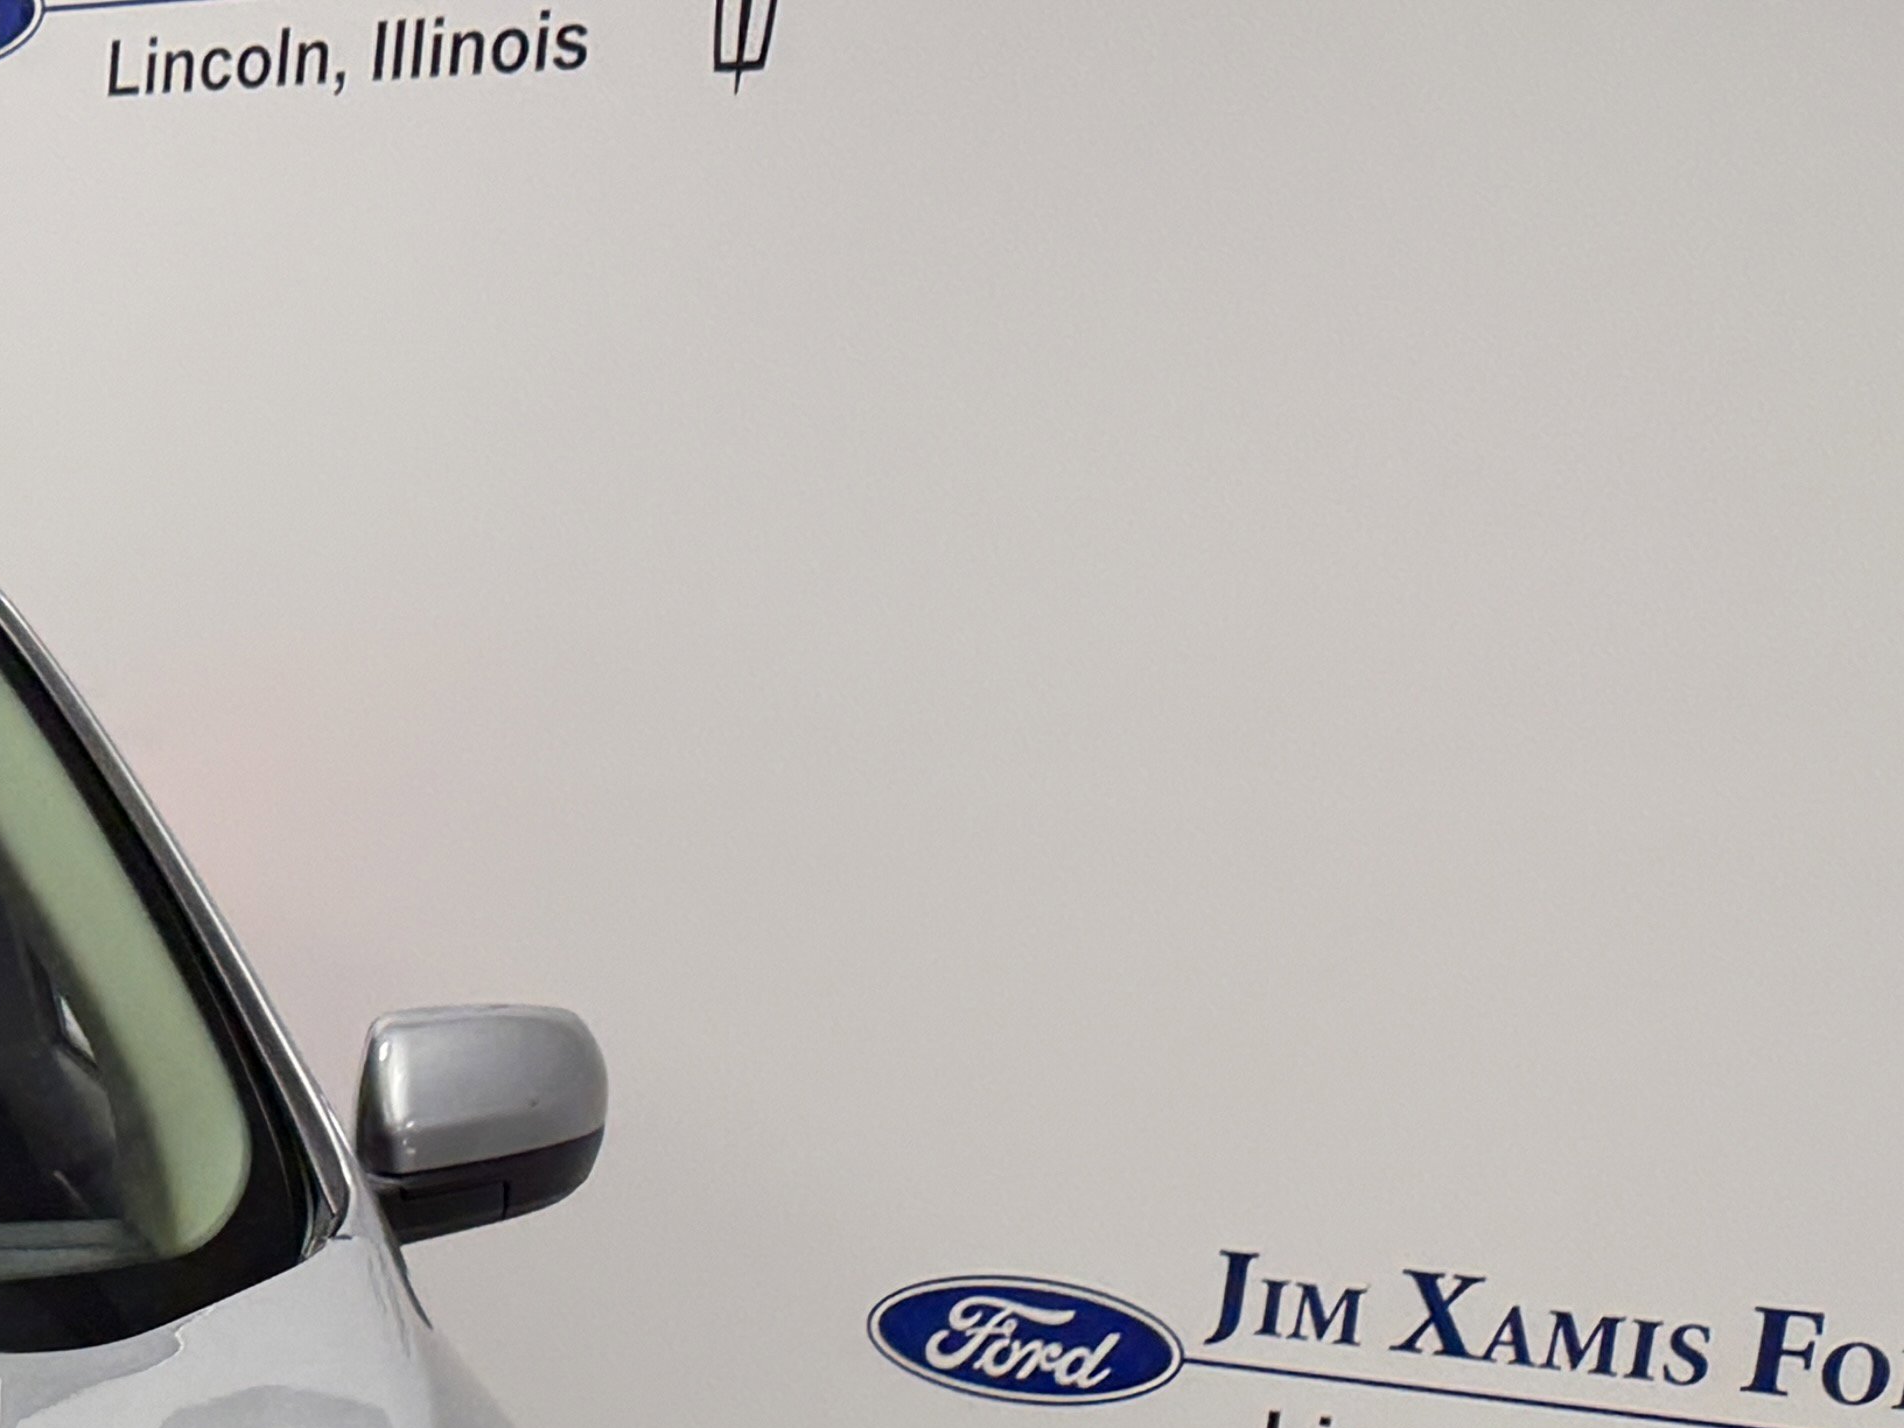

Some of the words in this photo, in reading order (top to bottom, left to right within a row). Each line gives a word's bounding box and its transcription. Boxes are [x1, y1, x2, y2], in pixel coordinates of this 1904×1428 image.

[107, 26, 346, 97] Lincoln,
[372, 9, 588, 82] Illinois
[925, 1295, 1111, 1389] Ford
[1204, 1249, 1369, 1347] JIM
[1389, 1267, 1711, 1387] XAMIS
